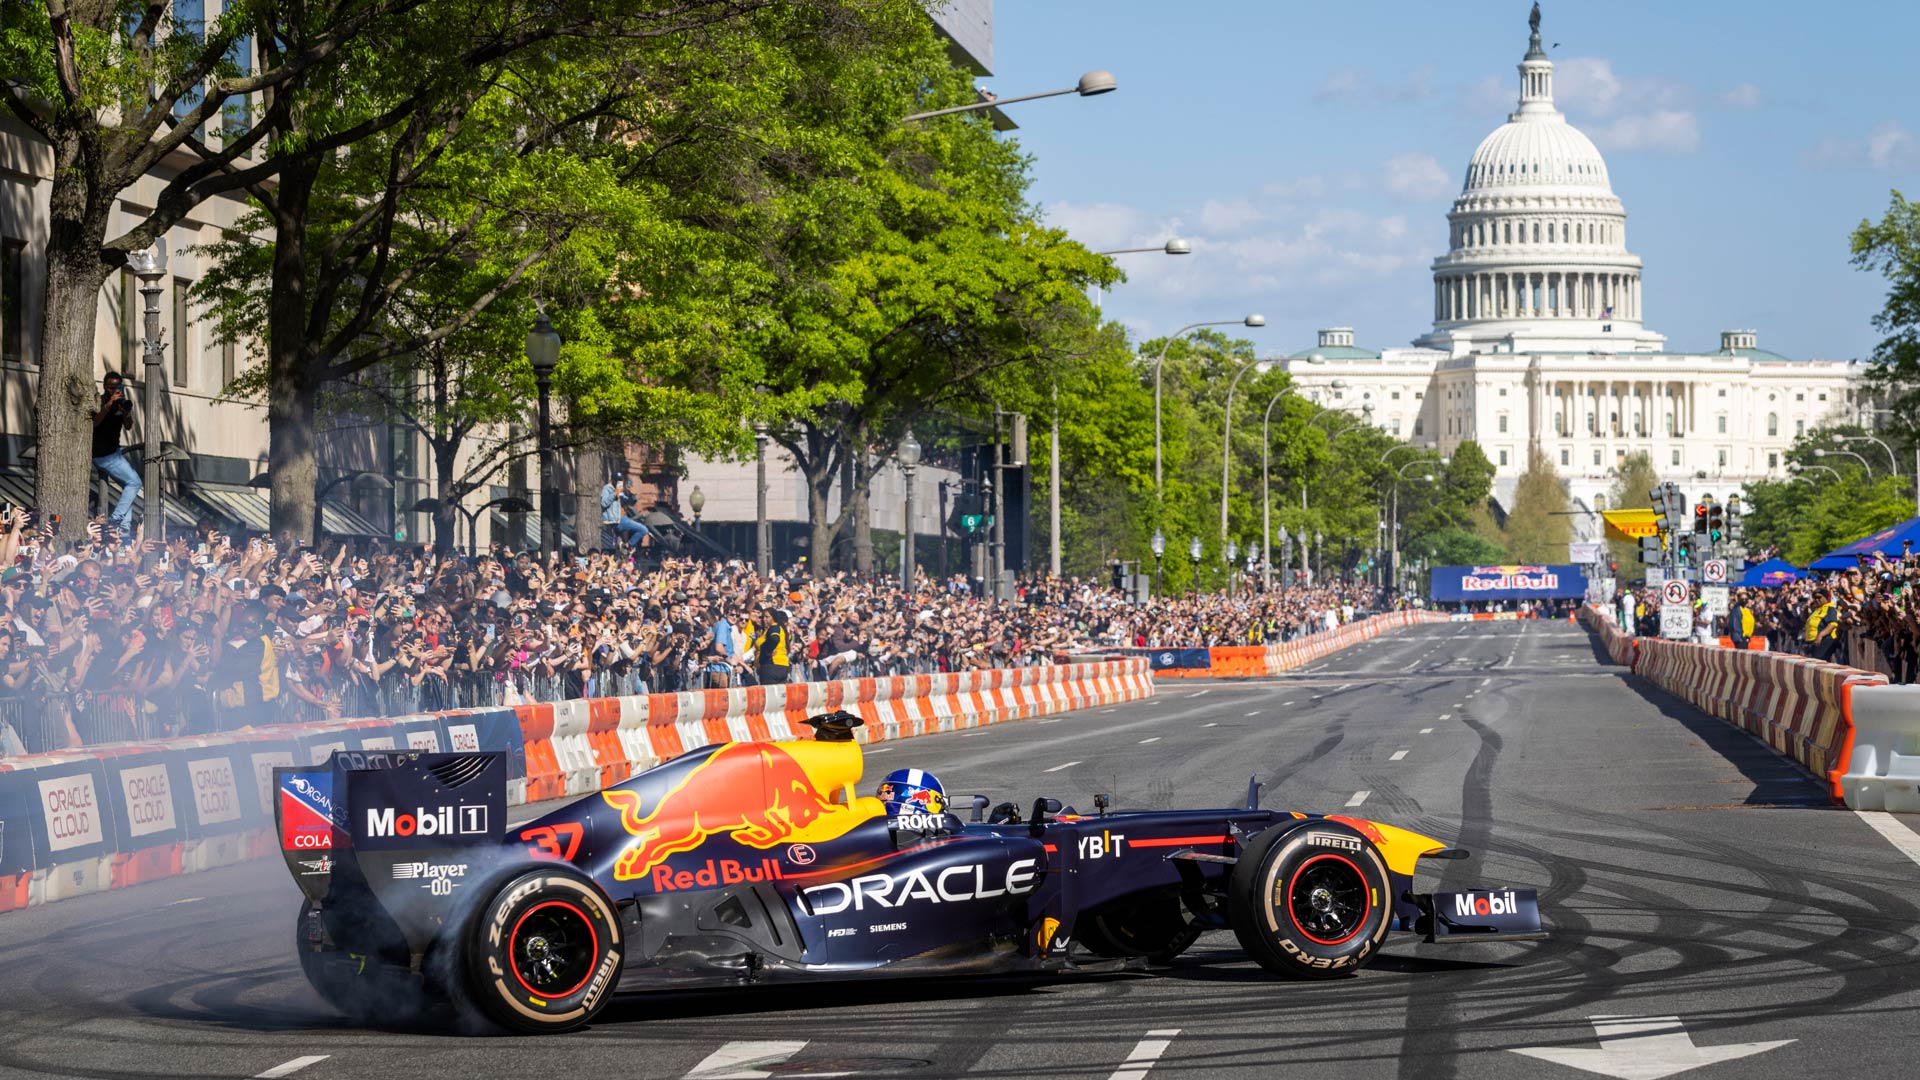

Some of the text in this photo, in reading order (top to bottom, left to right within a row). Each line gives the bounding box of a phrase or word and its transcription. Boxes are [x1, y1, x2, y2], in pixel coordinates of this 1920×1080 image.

[967, 516, 975, 526] 6
[1462, 574, 1558, 591] Red Bull
[128, 774, 167, 800] ORACLE
[195, 764, 231, 790] ORACLE
[48, 785, 92, 813] ORACLE
[132, 800, 165, 824] CLOUD
[200, 791, 231, 815] CLOUD
[52, 812, 90, 839] CLOUD
[367, 806, 453, 837] Mobil
[467, 809, 477, 831] 1
[294, 834, 332, 848] COLA
[520, 821, 584, 862] 37
[1307, 831, 1362, 851] PIRELLI
[793, 846, 811, 864] E
[412, 862, 467, 880] Player
[651, 858, 783, 893] Red Bull
[797, 858, 1036, 916] ORACLE
[489, 877, 543, 948] ZERO
[1455, 891, 1517, 916] Mobil
[869, 922, 907, 933] SIEMENS
[1278, 938, 1351, 969] ZERO
[581, 949, 620, 1011] PIRELLI
